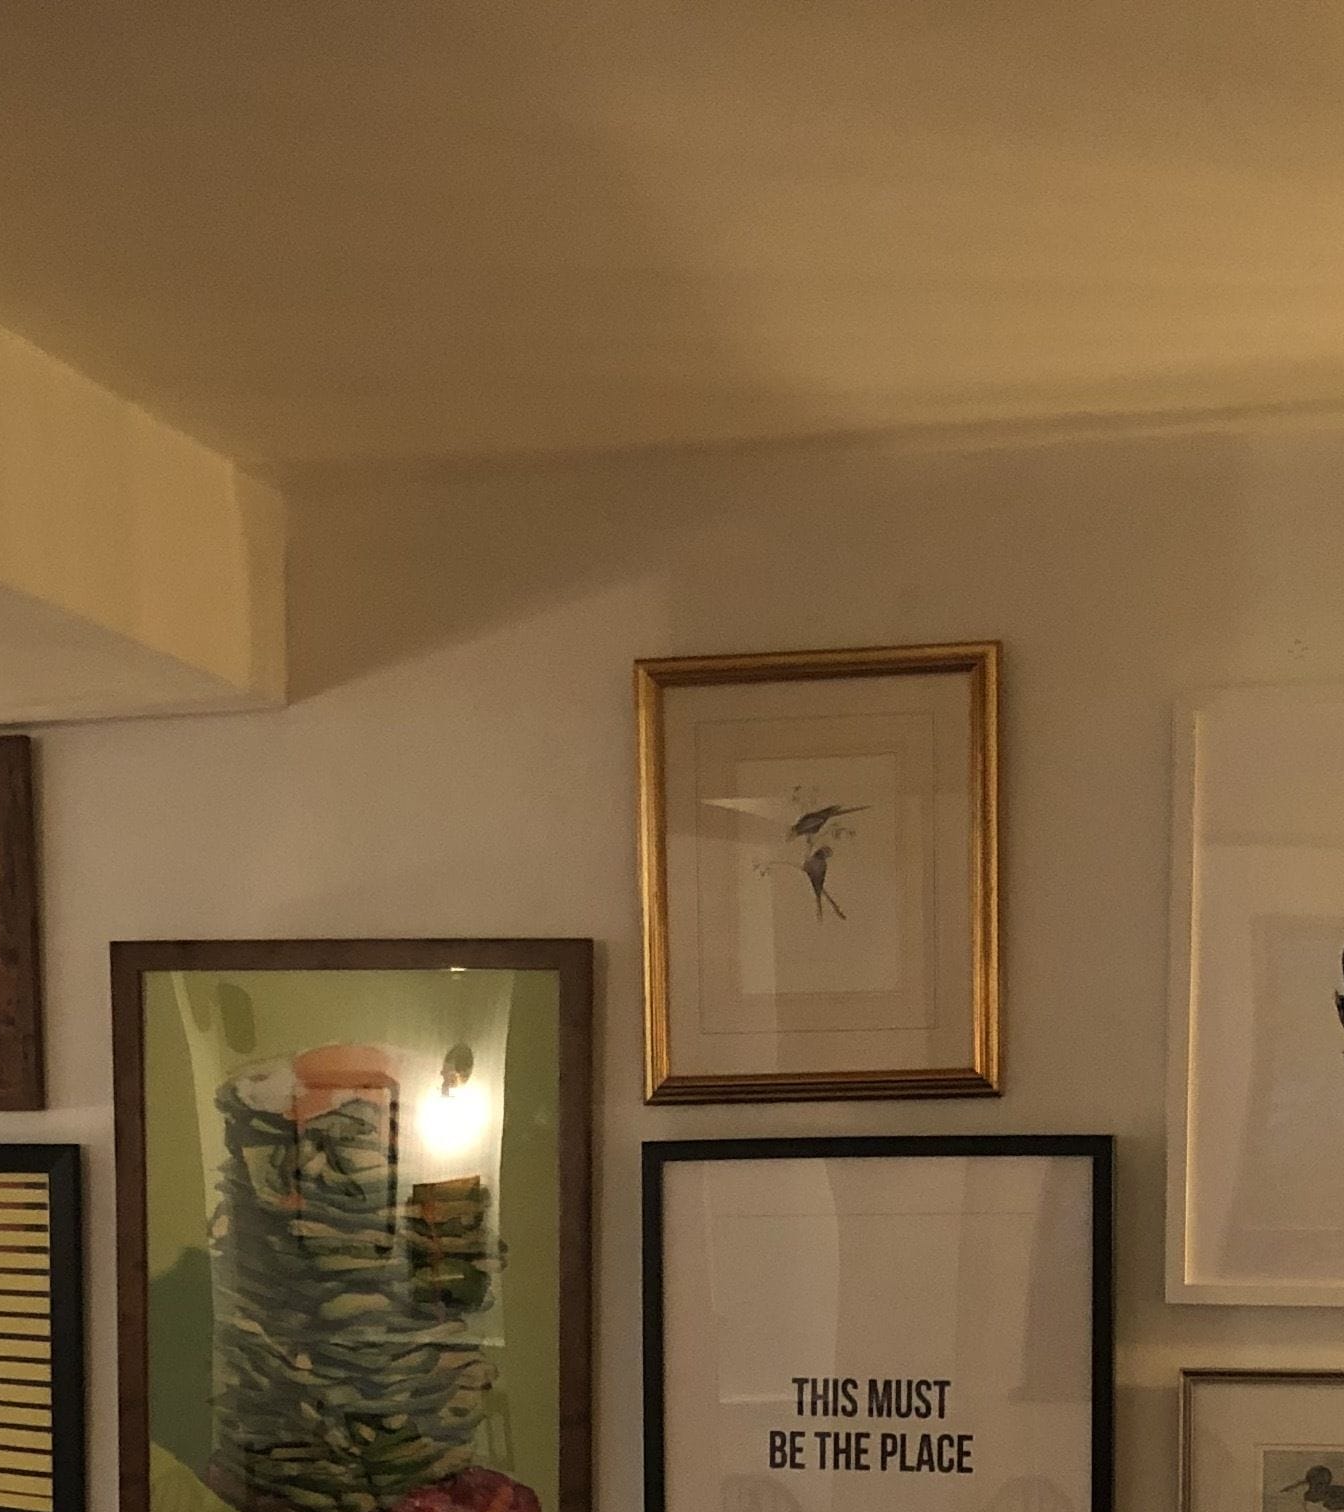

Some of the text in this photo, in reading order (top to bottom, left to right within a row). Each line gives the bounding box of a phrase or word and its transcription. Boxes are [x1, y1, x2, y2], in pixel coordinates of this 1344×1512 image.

[792, 1377, 952, 1419] THIS MUST
[769, 1430, 974, 1474] BE THE PLACE
